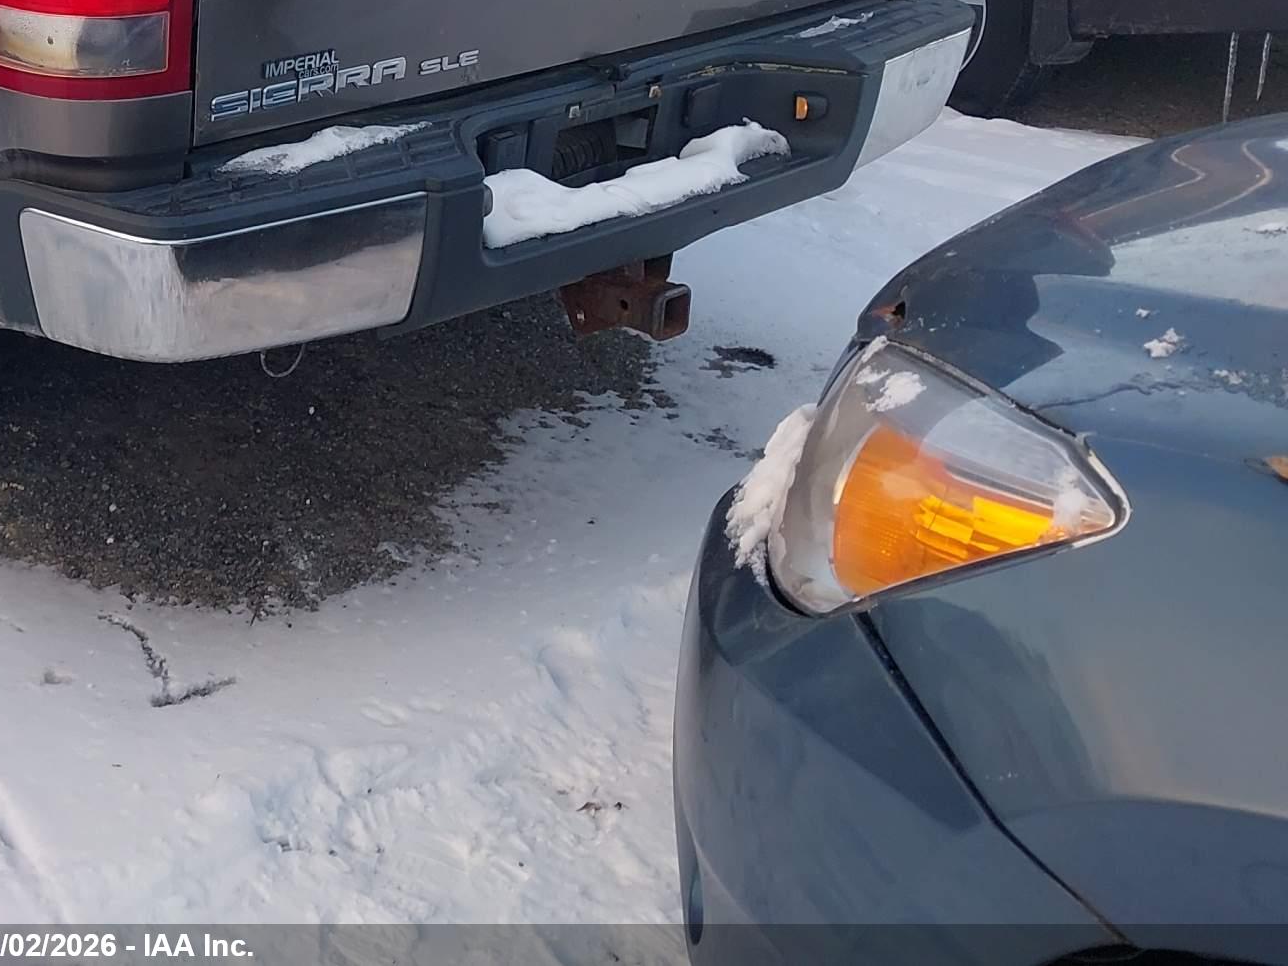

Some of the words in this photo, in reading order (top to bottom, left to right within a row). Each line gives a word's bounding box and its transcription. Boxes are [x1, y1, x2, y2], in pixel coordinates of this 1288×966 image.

[265, 50, 340, 79] IMPERIAL
[298, 63, 339, 79] cars.com
[210, 56, 408, 122] SIERRA
[419, 49, 480, 76] SLE
